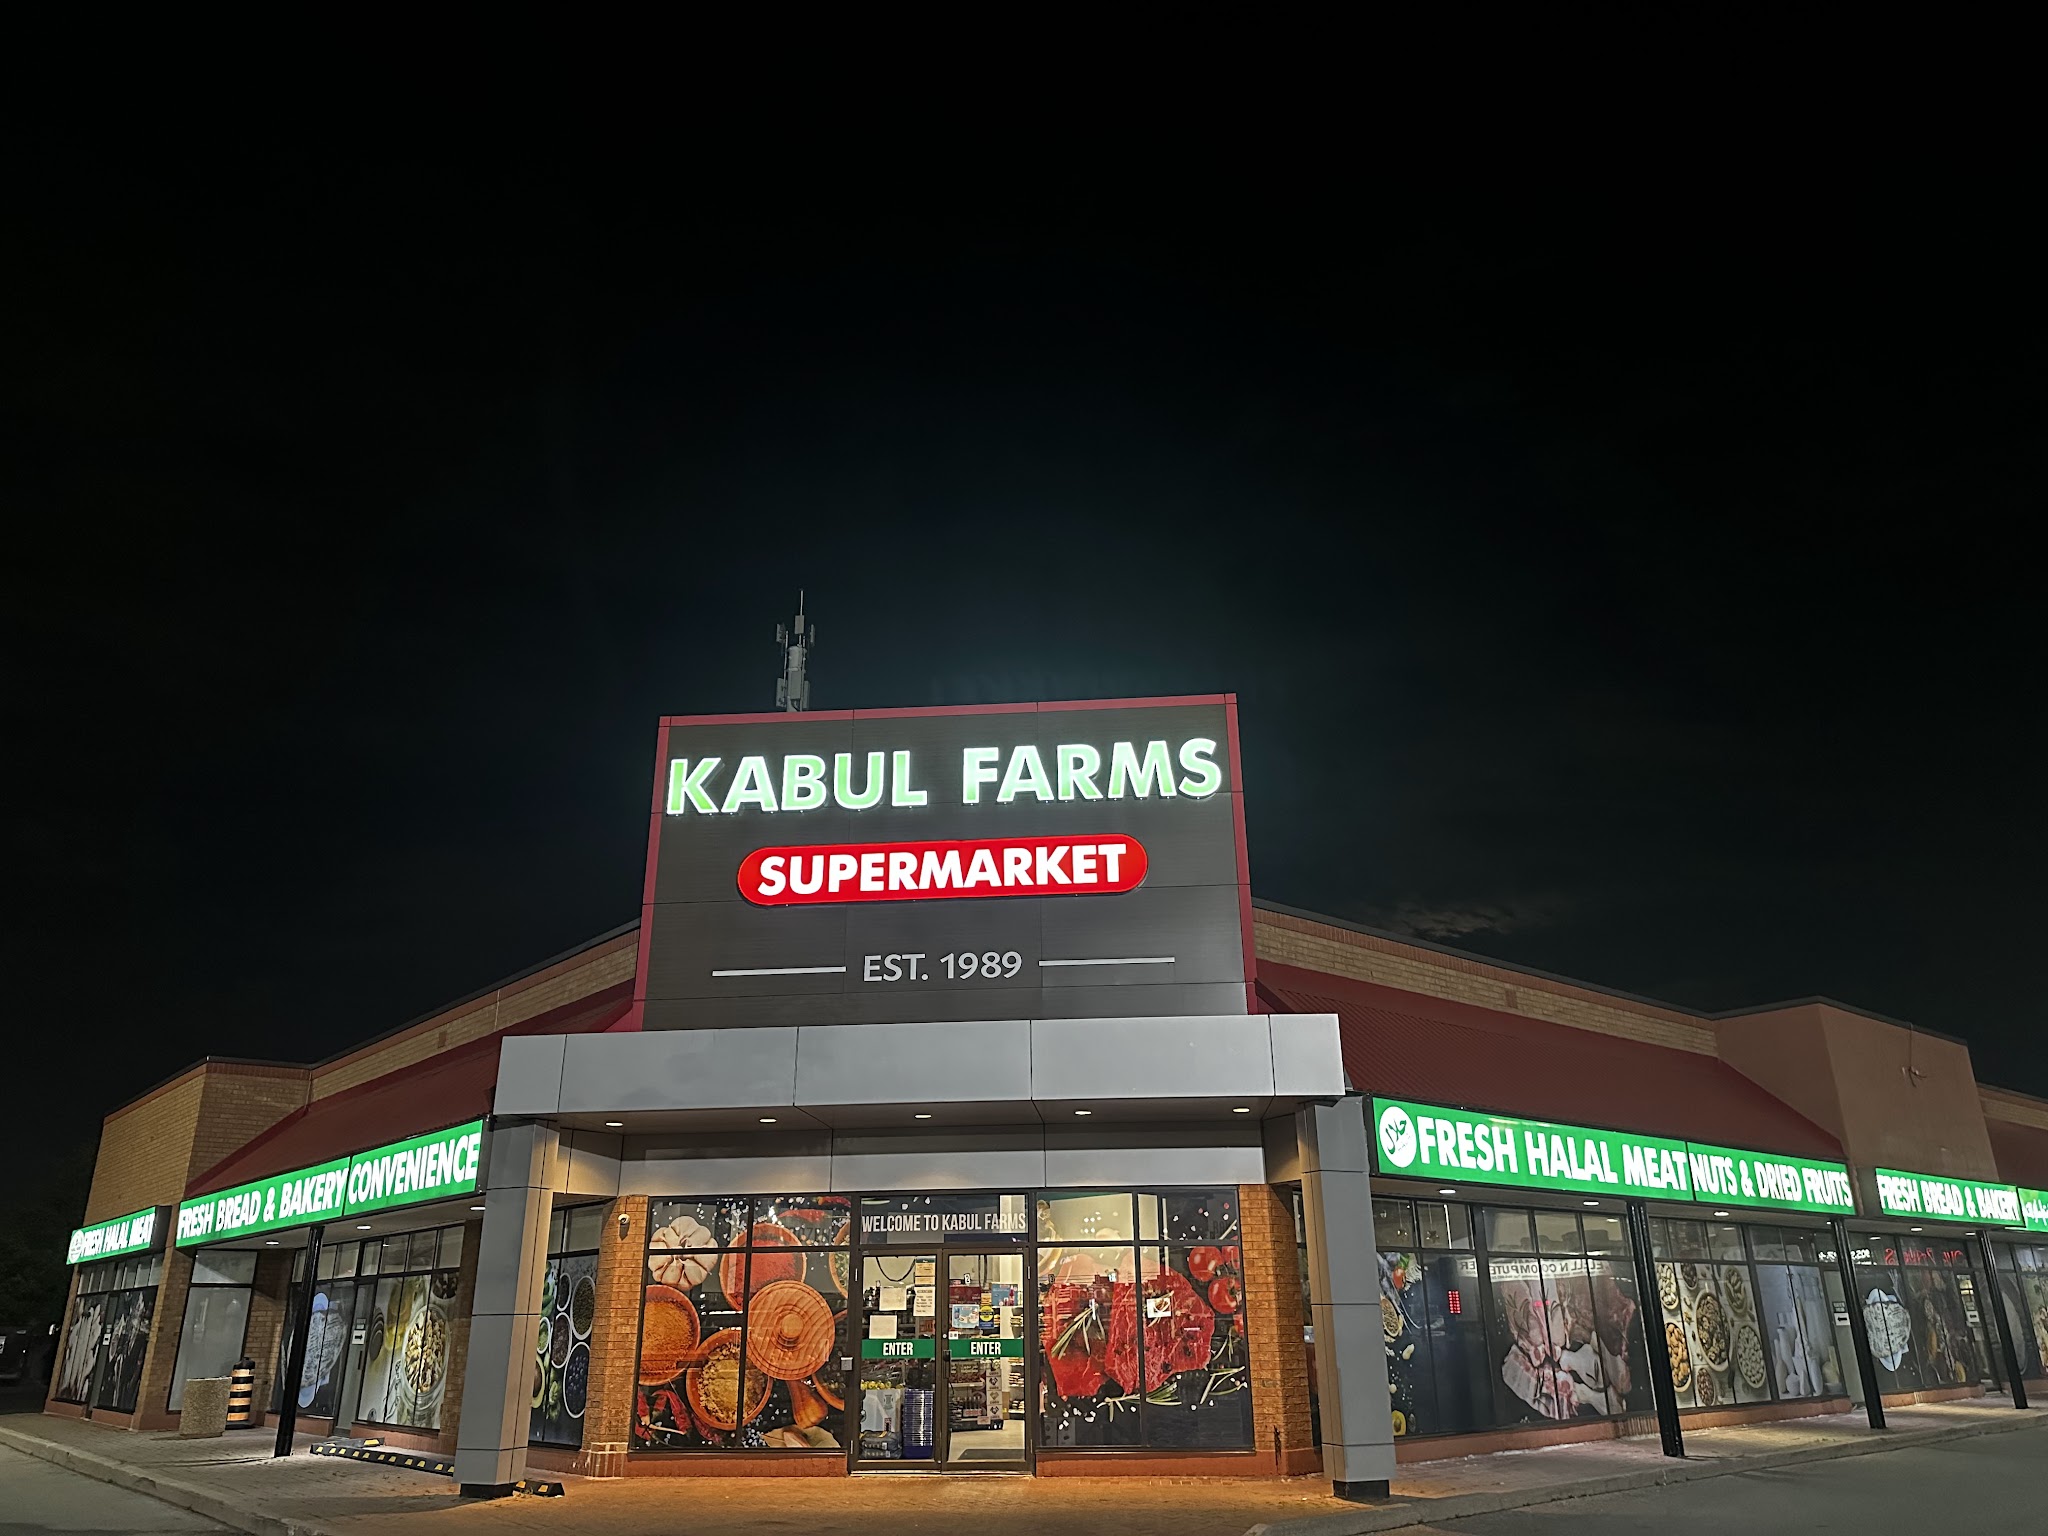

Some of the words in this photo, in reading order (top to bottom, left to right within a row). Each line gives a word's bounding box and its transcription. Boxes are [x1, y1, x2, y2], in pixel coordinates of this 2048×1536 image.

[667, 750, 928, 816] KABUL
[963, 738, 1222, 806] FARMS
[757, 843, 1127, 896] SUPERMARKET
[863, 953, 929, 982] EST.
[939, 951, 1022, 980] 1989
[348, 1132, 482, 1205] CONVENIENCE
[1417, 1115, 1518, 1173] FRESH
[1524, 1131, 1619, 1184] HALAL
[1622, 1144, 1688, 1191] MEAT
[176, 1201, 215, 1240] FRESH
[215, 1190, 262, 1232] BREAD
[263, 1187, 276, 1223] &
[279, 1168, 349, 1219] BAKERY
[1688, 1153, 1738, 1196] NUTS
[1739, 1160, 1756, 1197] &
[1754, 1161, 1802, 1202] DRIED
[1802, 1167, 1853, 1208] FRUITS
[1876, 1174, 1922, 1213] FRESH
[1920, 1180, 1965, 1216] BREAD
[1964, 1186, 1978, 1218] &
[1975, 1187, 2020, 1221] BAKERY
[81, 1227, 106, 1258] FRESH
[102, 1220, 130, 1253] HALAL
[128, 1212, 155, 1247] MEAT
[862, 1214, 921, 1233] WELCOME
[923, 1214, 939, 1231] TO
[942, 1213, 982, 1231] KABUL
[984, 1213, 1026, 1230] FARMS
[882, 1342, 914, 1356] ENTER
[970, 1341, 1001, 1355] ENTER
